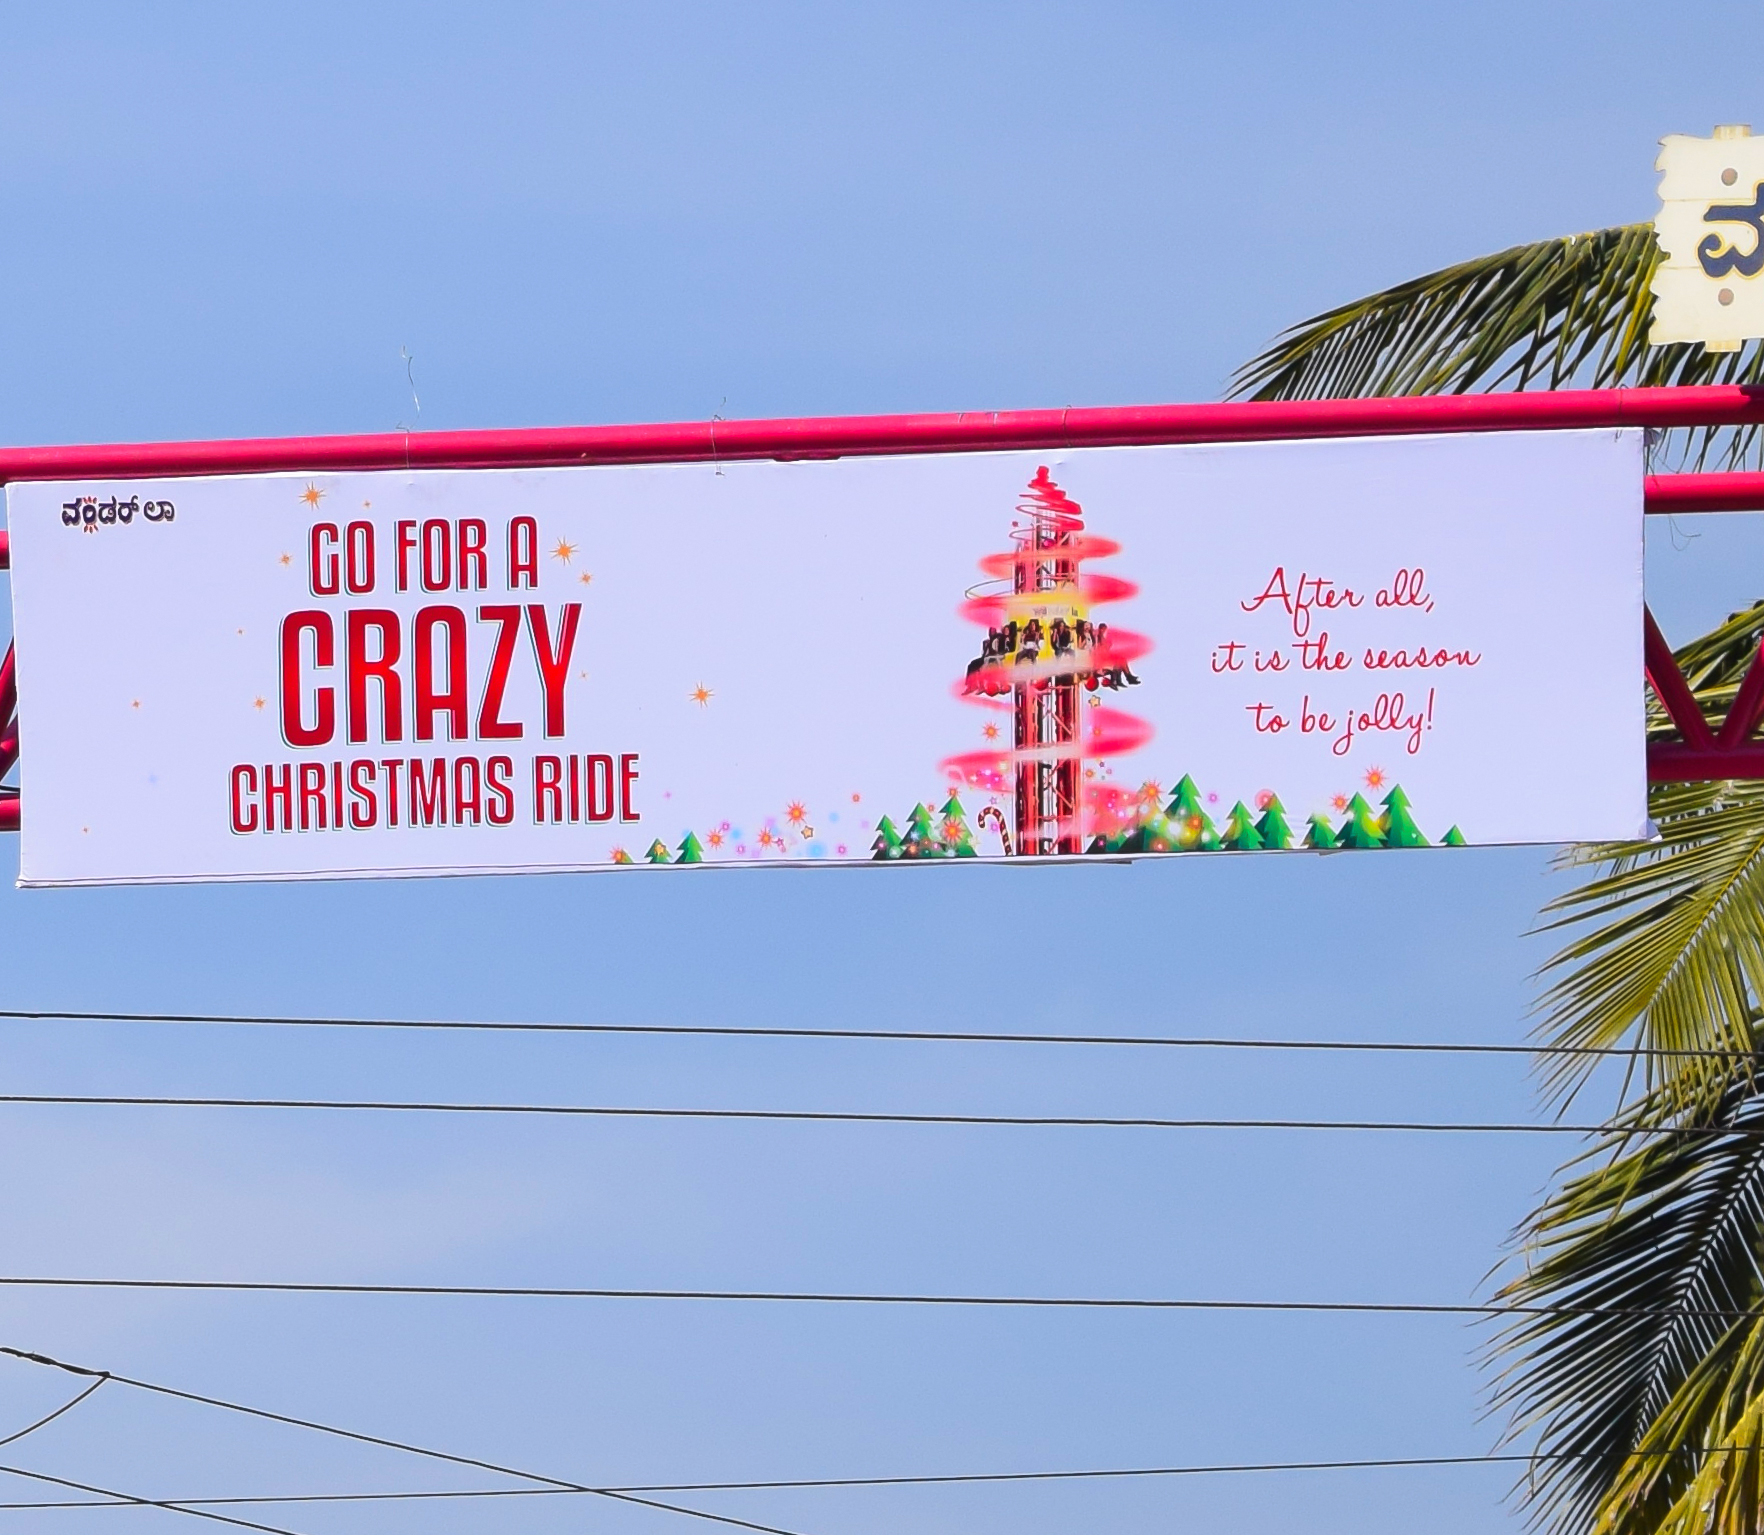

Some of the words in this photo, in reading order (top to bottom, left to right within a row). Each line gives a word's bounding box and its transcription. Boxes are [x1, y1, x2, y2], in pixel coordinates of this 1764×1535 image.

[308, 520, 376, 598] GO
[393, 517, 489, 594] FOR
[506, 515, 539, 591] A
[1240, 566, 1365, 638] After
[1375, 568, 1435, 613] all,
[279, 602, 583, 749] CRAZY
[1211, 640, 1247, 673] it
[1254, 650, 1291, 672] is
[1291, 631, 1353, 671] the
[1363, 646, 1483, 670] season
[1245, 701, 1291, 734] to
[1300, 694, 1337, 733] be
[1332, 687, 1435, 756] jolly!
[228, 755, 514, 836] CHRISTMAS
[531, 753, 641, 826] RIDE
